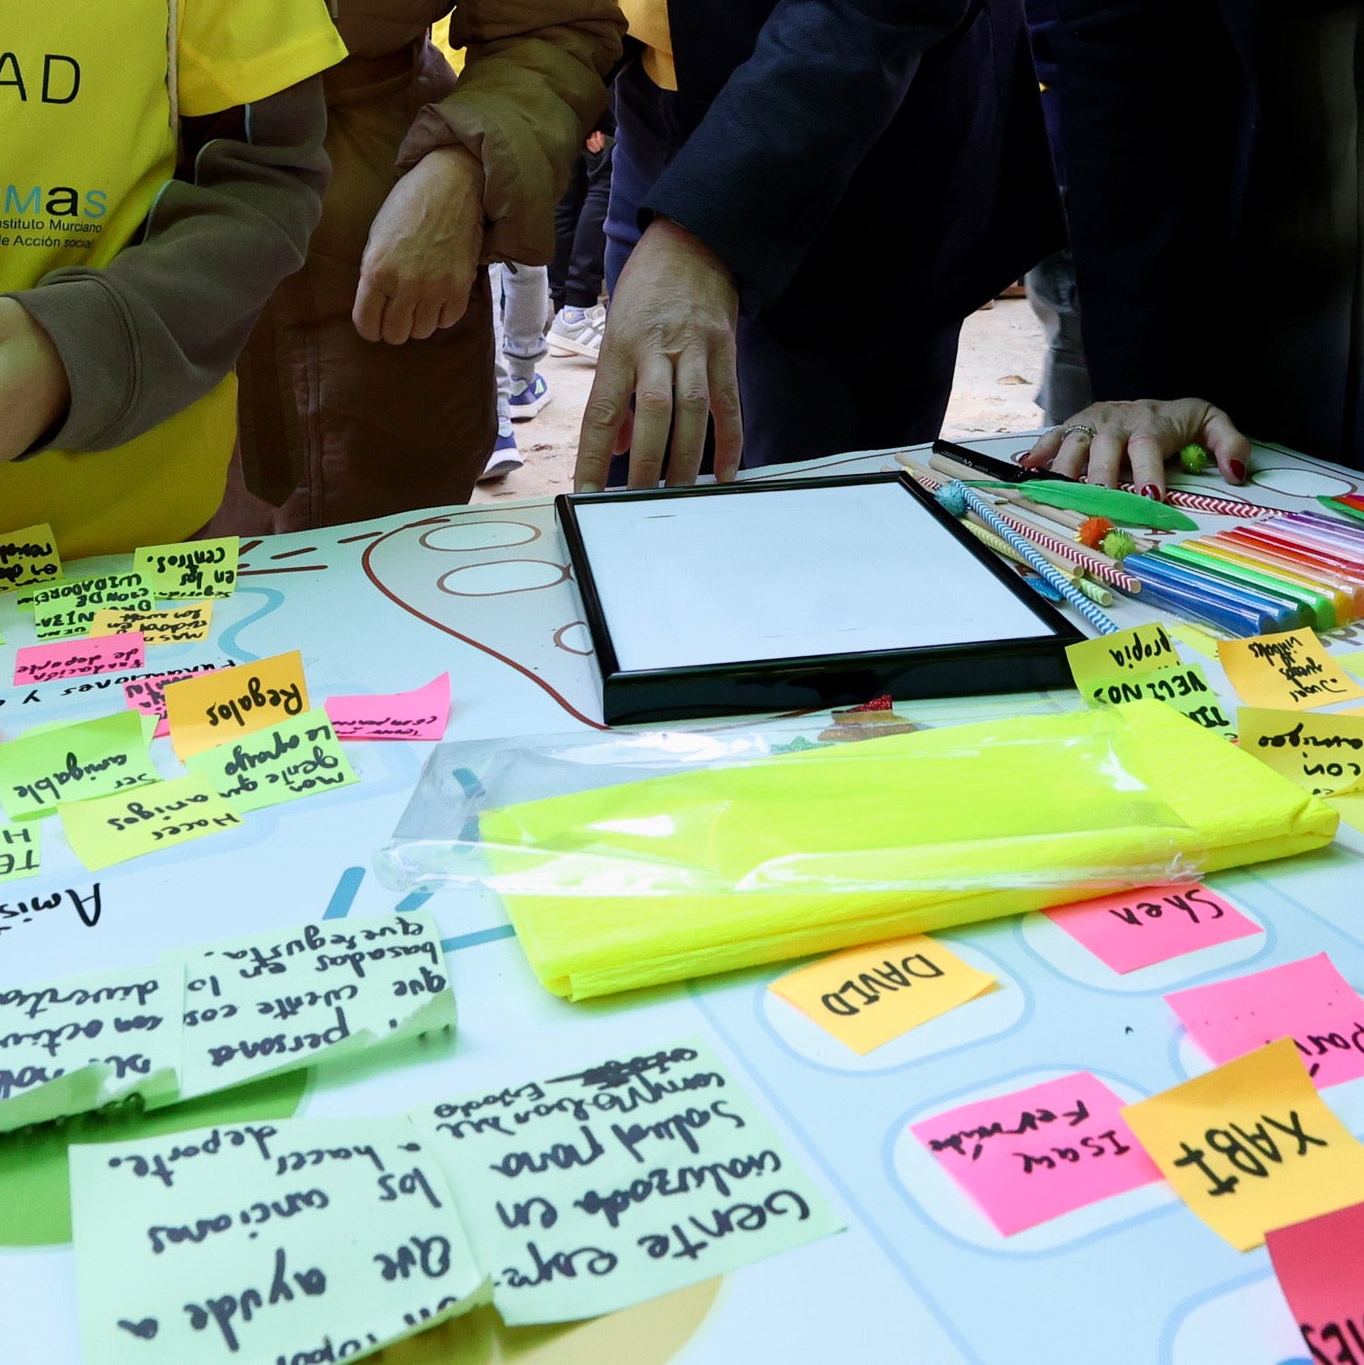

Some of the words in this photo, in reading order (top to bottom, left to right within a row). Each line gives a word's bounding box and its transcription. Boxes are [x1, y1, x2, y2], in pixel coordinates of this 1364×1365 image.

[13, 235, 60, 248] Acción
[49, 219, 102, 233] Murciano
[206, 677, 304, 727] Regalos
[820, 954, 945, 1016] DAVID
[276, 1146, 384, 1176] hacer
[1173, 1111, 1330, 1197] XABI
[378, 1168, 442, 1208] los
[374, 1236, 451, 1280] Que
[184, 1248, 327, 1353] ayude
[118, 1319, 159, 1340] a
